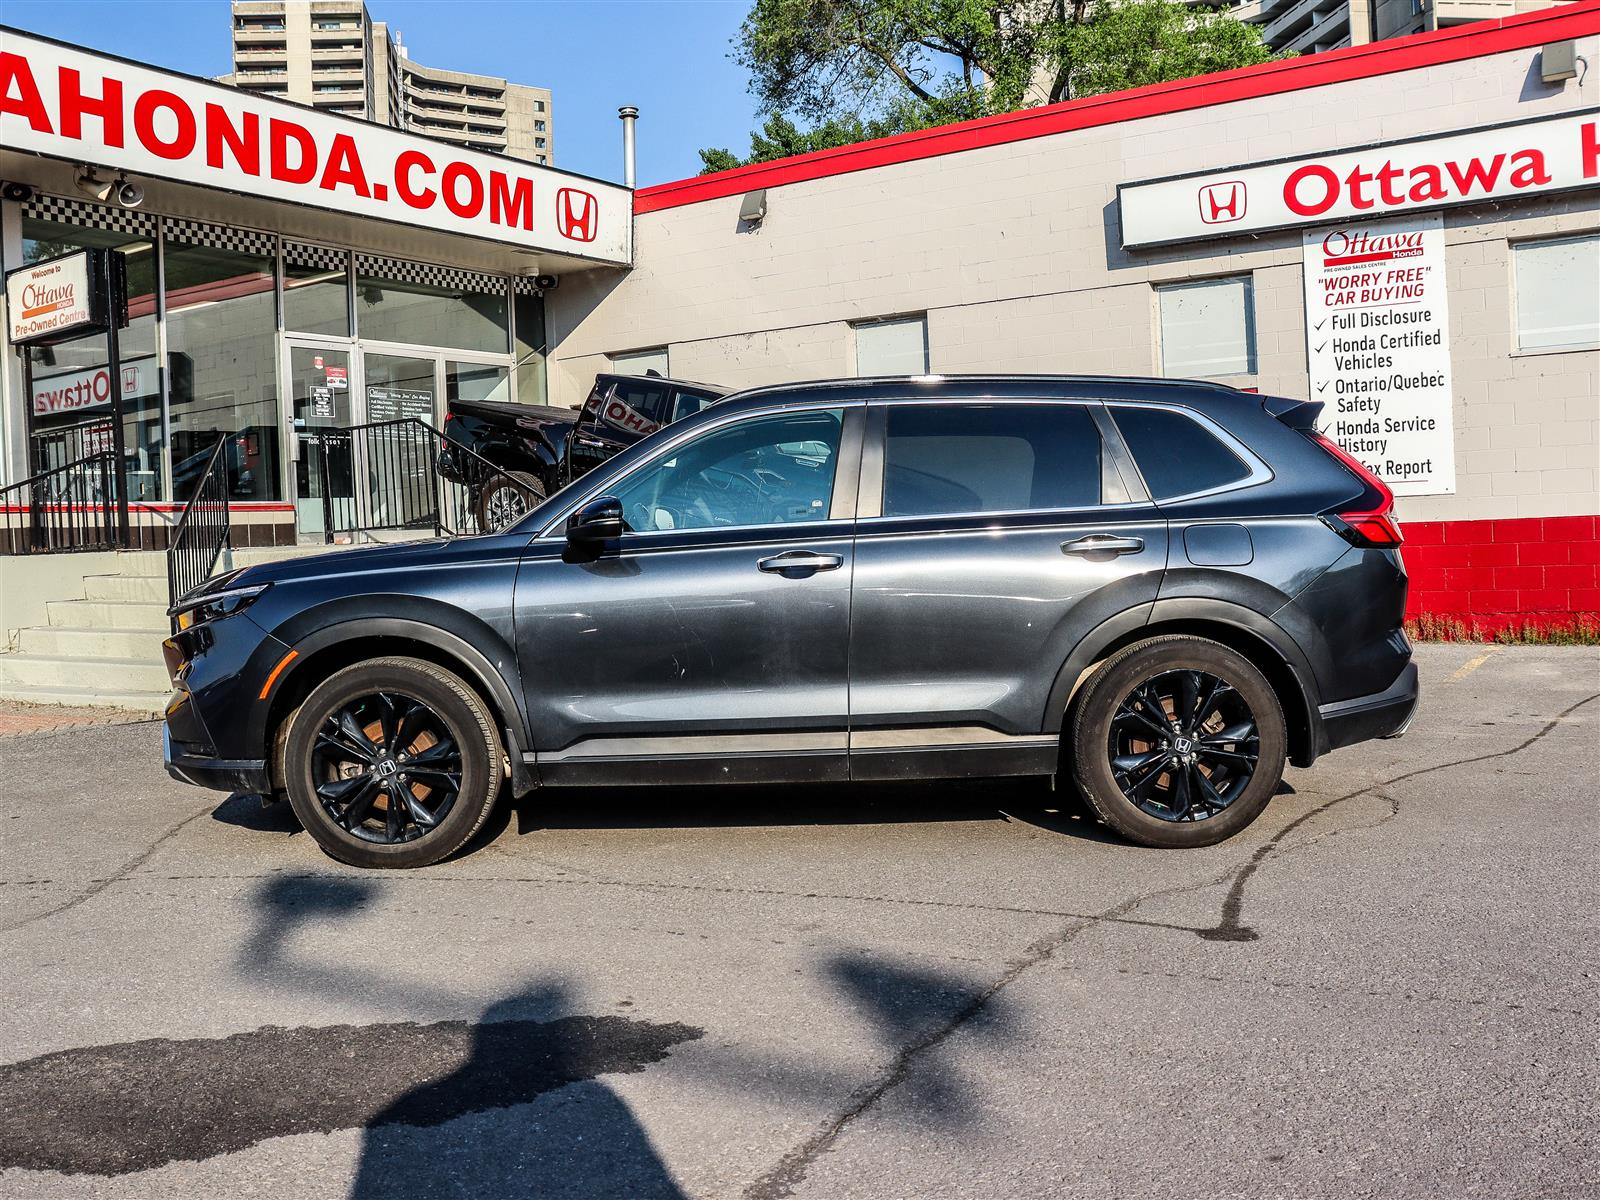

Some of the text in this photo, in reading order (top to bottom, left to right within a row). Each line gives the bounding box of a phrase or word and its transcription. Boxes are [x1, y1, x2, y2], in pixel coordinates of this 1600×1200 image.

[1283, 149, 1553, 216] Ottawa
[1323, 230, 1424, 257] Ottawa
[1392, 249, 1423, 259] Honda
[31, 268, 54, 279] Welcome
[1318, 266, 1431, 291] "WORRY FREE"
[22, 282, 74, 309] Ottawa
[1325, 283, 1425, 307] CAR BUYING
[15, 310, 86, 336] Pre-Owned Centre
[1332, 309, 1432, 330] Full Disclosure
[1333, 329, 1441, 353] Honda Certified
[1334, 353, 1393, 371] Vehicles
[1335, 372, 1445, 394] Ontario/Quebec
[1337, 396, 1381, 415] Safety
[1337, 416, 1436, 436] Honda Service
[1338, 438, 1387, 455] History
[1386, 459, 1432, 479] Report
